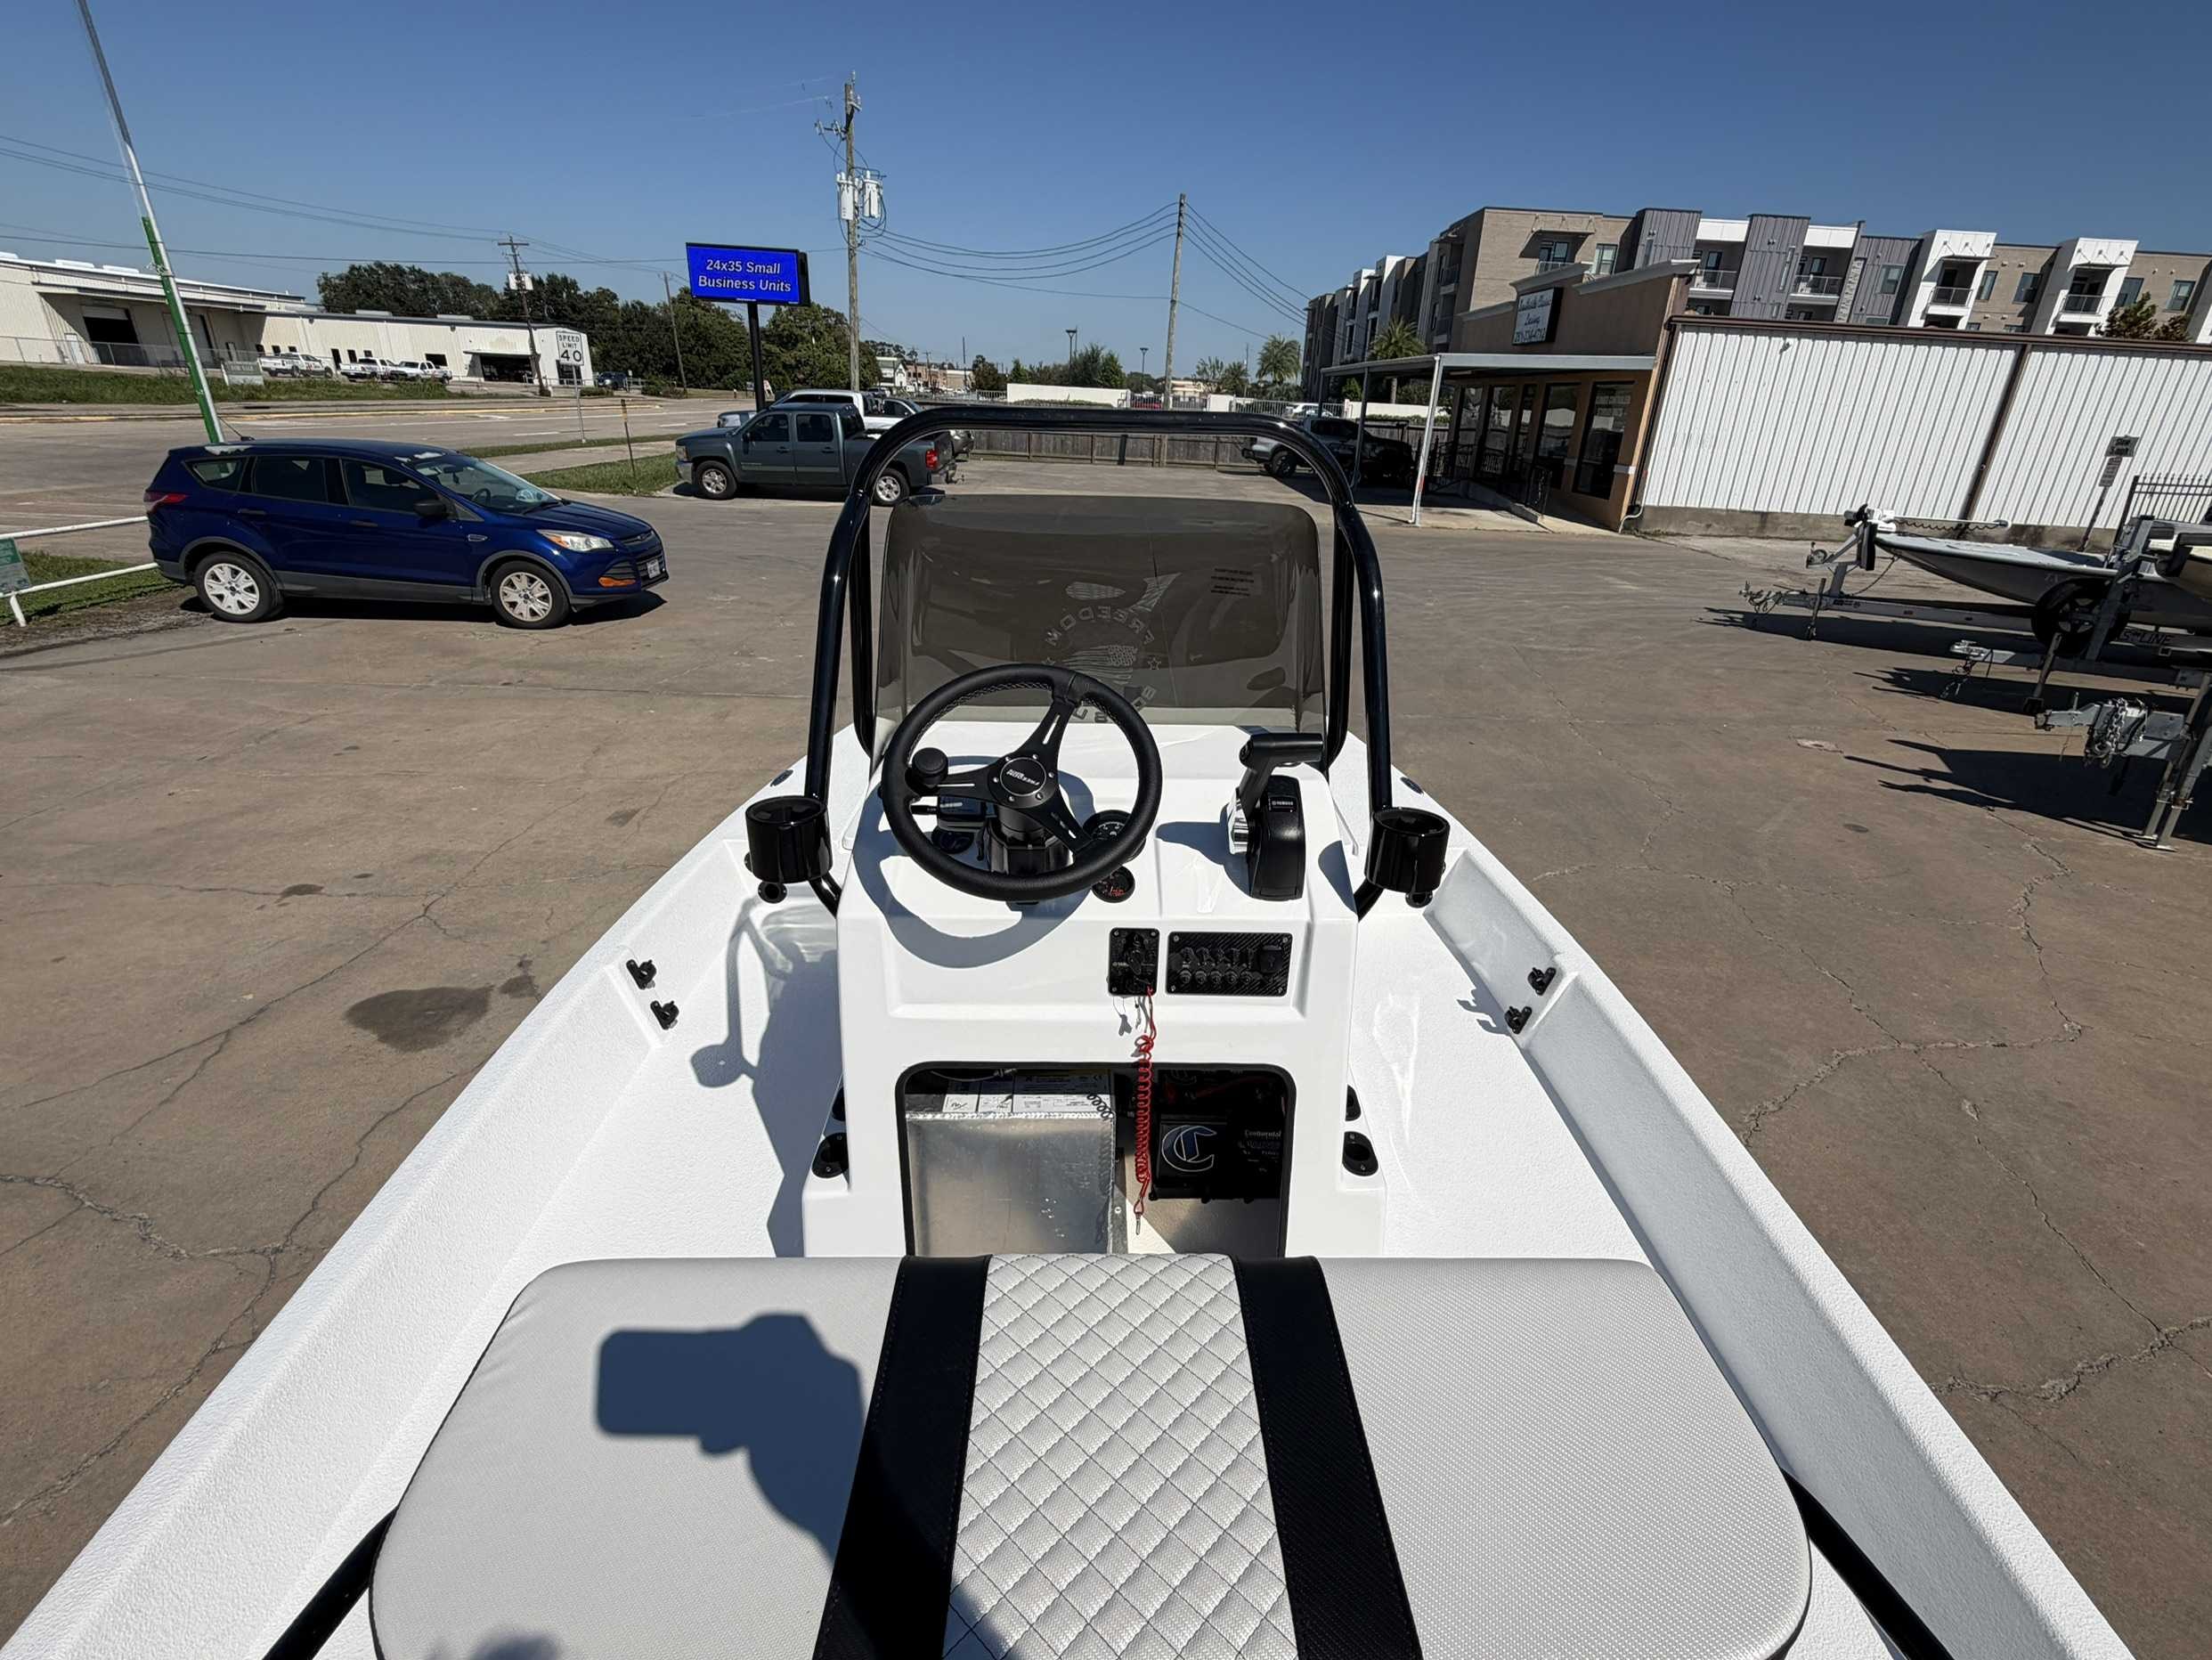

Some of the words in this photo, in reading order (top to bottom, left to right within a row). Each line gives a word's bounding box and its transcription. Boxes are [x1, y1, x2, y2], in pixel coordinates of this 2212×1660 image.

[706, 259, 743, 273] 24x35
[746, 261, 780, 274] Small
[698, 275, 755, 289] Business
[759, 279, 792, 292] Units
[560, 349, 581, 362] 40
